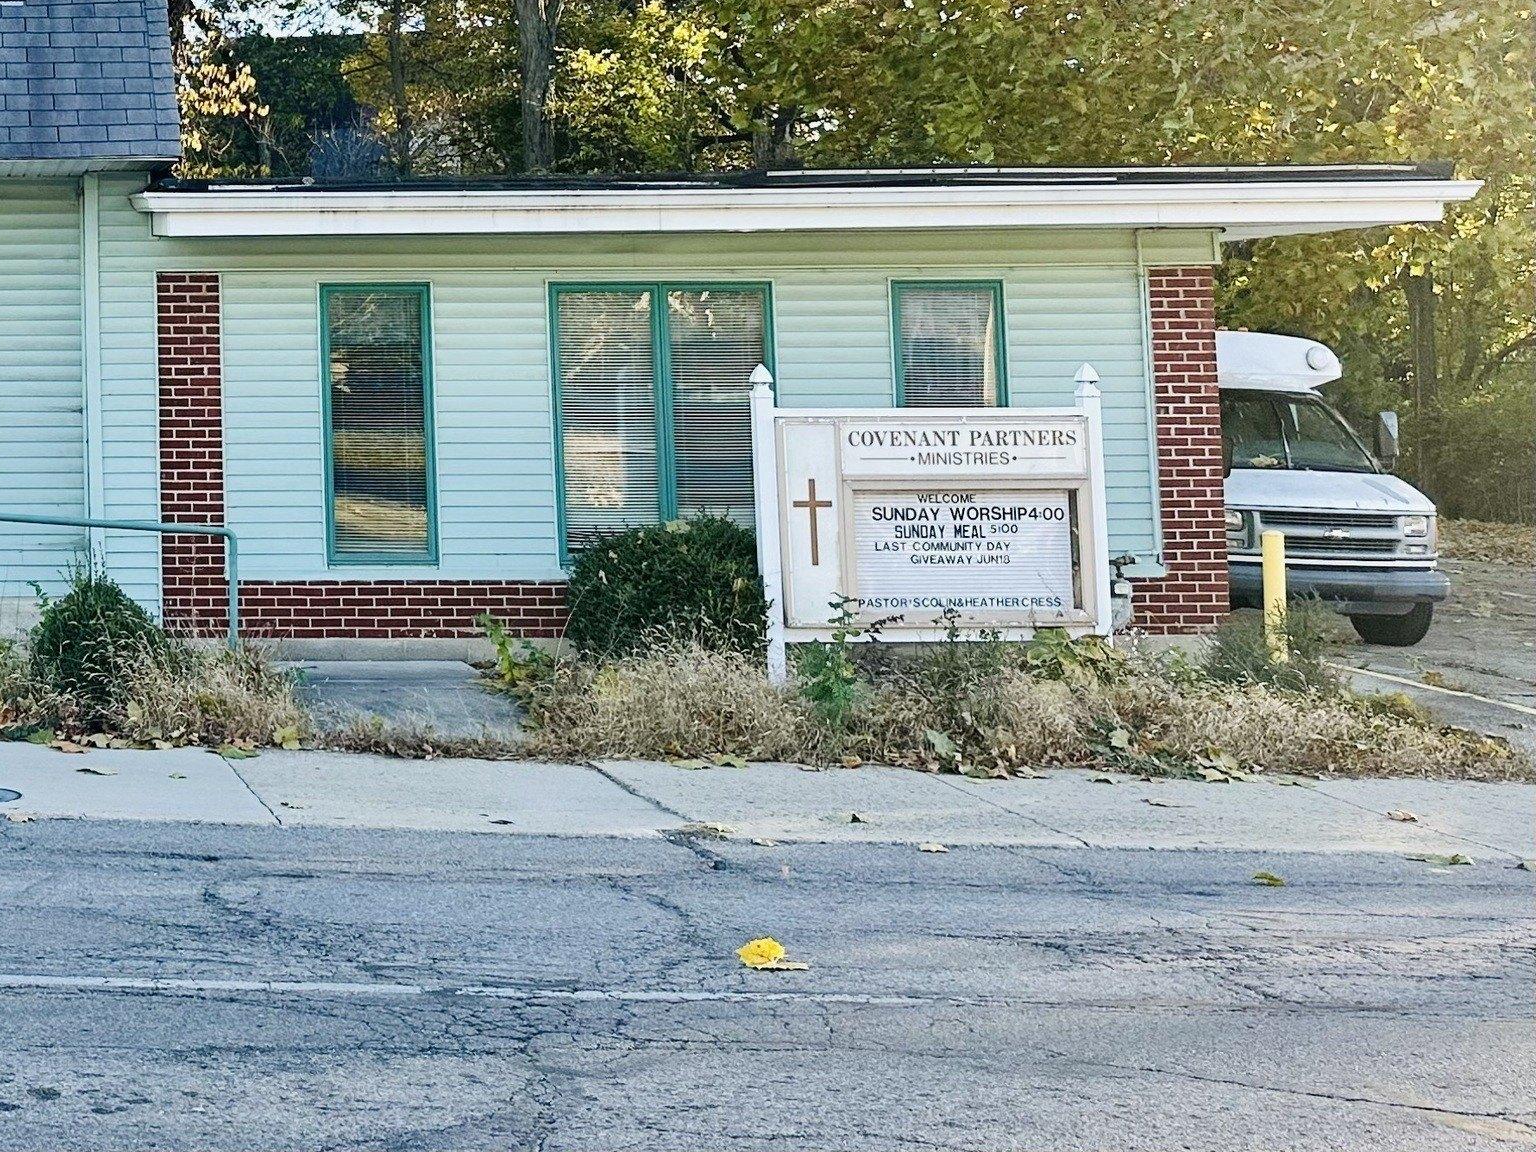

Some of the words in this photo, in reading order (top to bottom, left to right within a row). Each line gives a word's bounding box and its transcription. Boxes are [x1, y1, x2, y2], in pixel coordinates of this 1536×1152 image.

[848, 430, 960, 447] COVENANT
[970, 430, 1077, 446] PARTNERS
[918, 452, 1010, 465] MINISTRIES
[917, 493, 976, 503] WELCOME
[872, 507, 940, 521] SUNDAY
[894, 524, 945, 539] SUNDAY
[954, 524, 986, 539] MEAL
[874, 541, 906, 552] LAST
[912, 541, 982, 552] COMMUNITY
[986, 541, 1011, 551] DAY
[910, 554, 973, 565] GIVEAWAY
